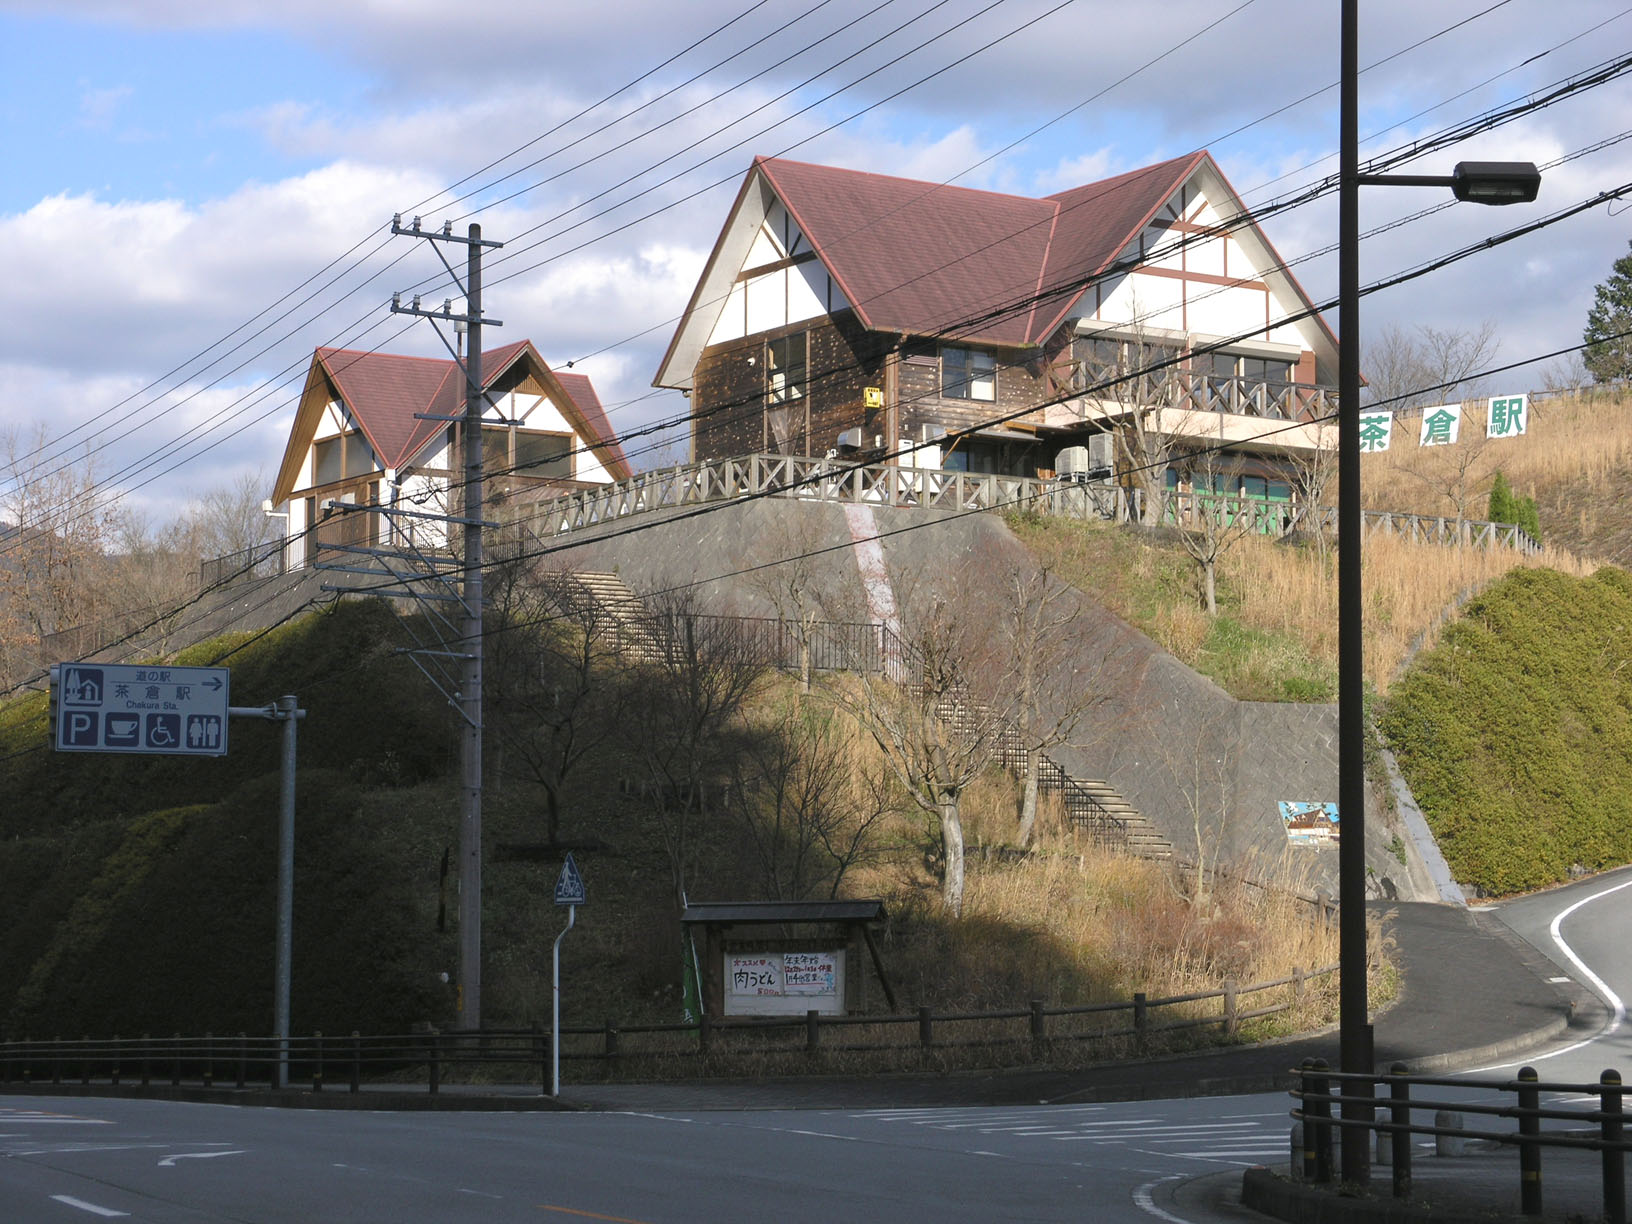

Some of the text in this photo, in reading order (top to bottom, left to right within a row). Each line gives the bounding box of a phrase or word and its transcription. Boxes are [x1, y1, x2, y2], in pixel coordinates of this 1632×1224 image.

[135, 670, 171, 682] 道の駅
[126, 700, 179, 711] Chakura Sta.
[70, 713, 91, 744] P
[734, 968, 776, 990] 肉うどん
